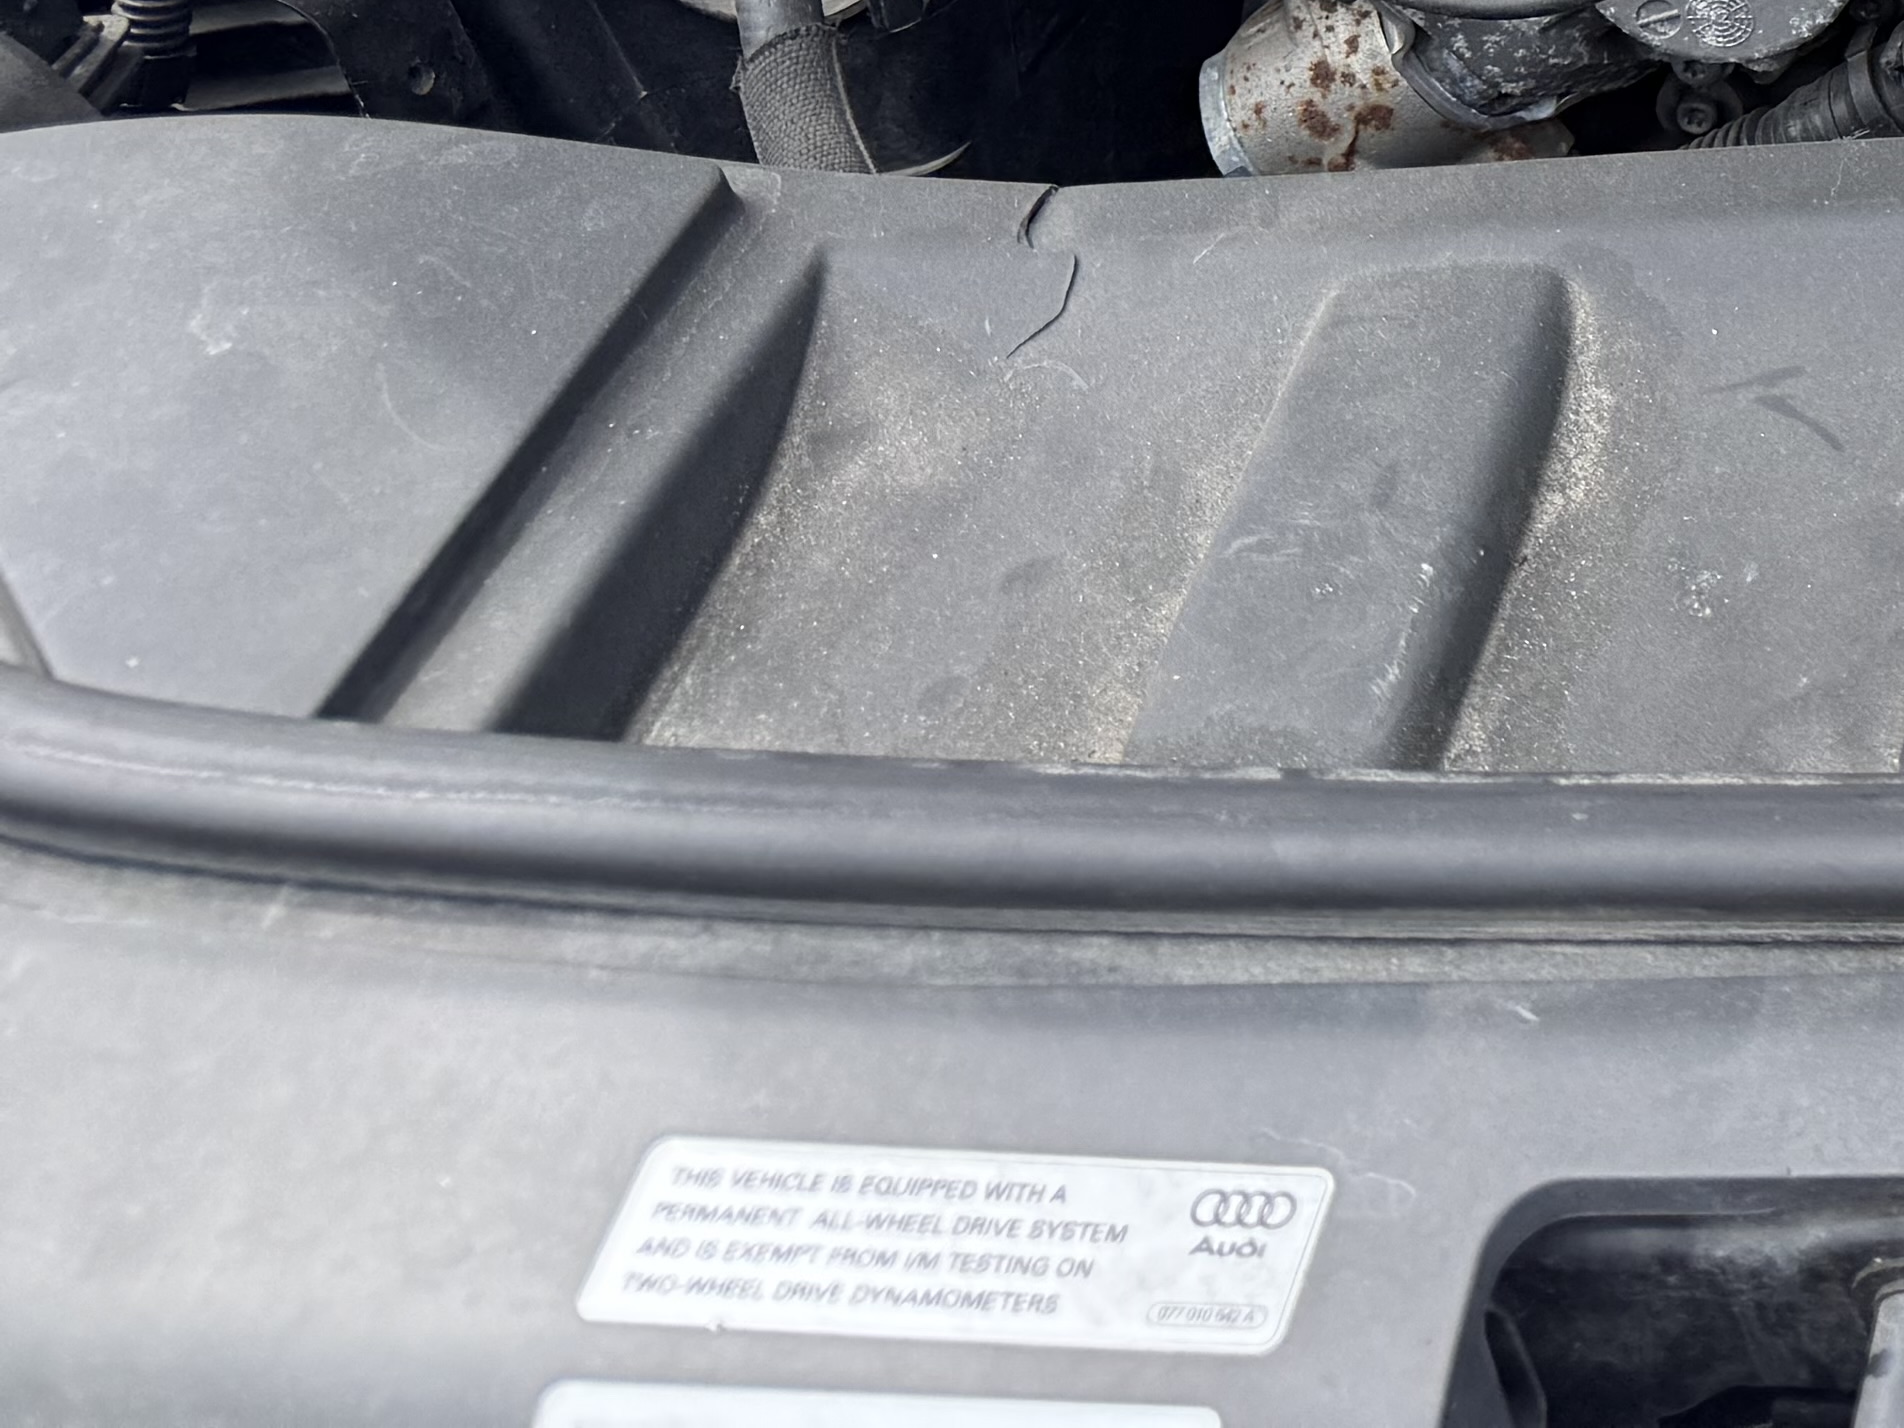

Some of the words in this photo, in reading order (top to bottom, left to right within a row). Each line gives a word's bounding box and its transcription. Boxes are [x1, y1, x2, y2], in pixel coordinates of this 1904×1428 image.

[672, 1166, 724, 1188] THIS
[731, 1169, 825, 1193] VEHICLE
[858, 1175, 978, 1200] EQUIPPED
[984, 1179, 1046, 1203] WITH
[651, 1201, 803, 1226] PERMANENT
[808, 1208, 948, 1235] ALL-WHEEL
[951, 1216, 1024, 1239] DRIVE
[1027, 1220, 1128, 1243] SYSTEM
[636, 1237, 692, 1259] AND
[722, 1241, 824, 1265] EXEMPT
[826, 1247, 899, 1269] FROM
[950, 1251, 1051, 1278] TESTING
[1055, 1257, 1095, 1279] ON
[1188, 1235, 1267, 1258] Audi
[772, 1279, 844, 1305] DRIVE
[848, 1284, 1061, 1314] DYNAMOMETERS
